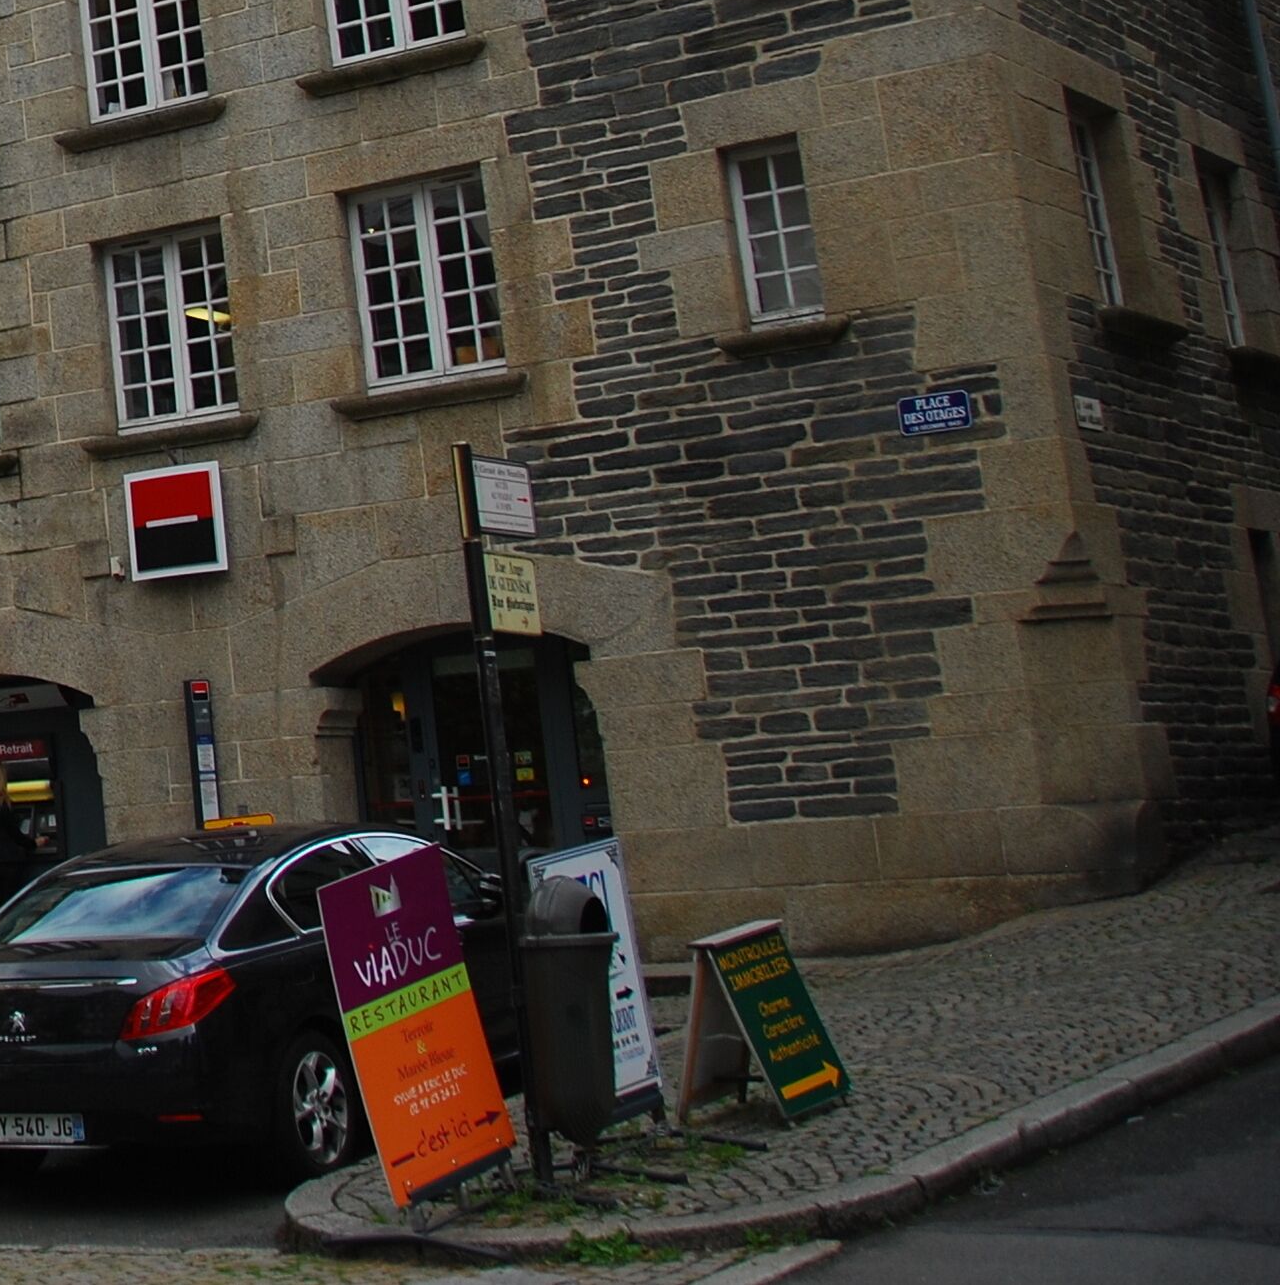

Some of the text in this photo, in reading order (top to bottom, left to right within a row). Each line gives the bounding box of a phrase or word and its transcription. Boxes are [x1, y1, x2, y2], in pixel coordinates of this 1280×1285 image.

[915, 395, 951, 410] PLACE
[903, 406, 966, 425] DES OTAGES
[0, 742, 34, 755] Retrait
[385, 921, 402, 942] LE
[728, 956, 790, 992] IMMOBILIER
[349, 970, 463, 1034] RESTAURANT
[416, 1039, 427, 1054] &
[417, 1112, 473, 1157] c'est ici
